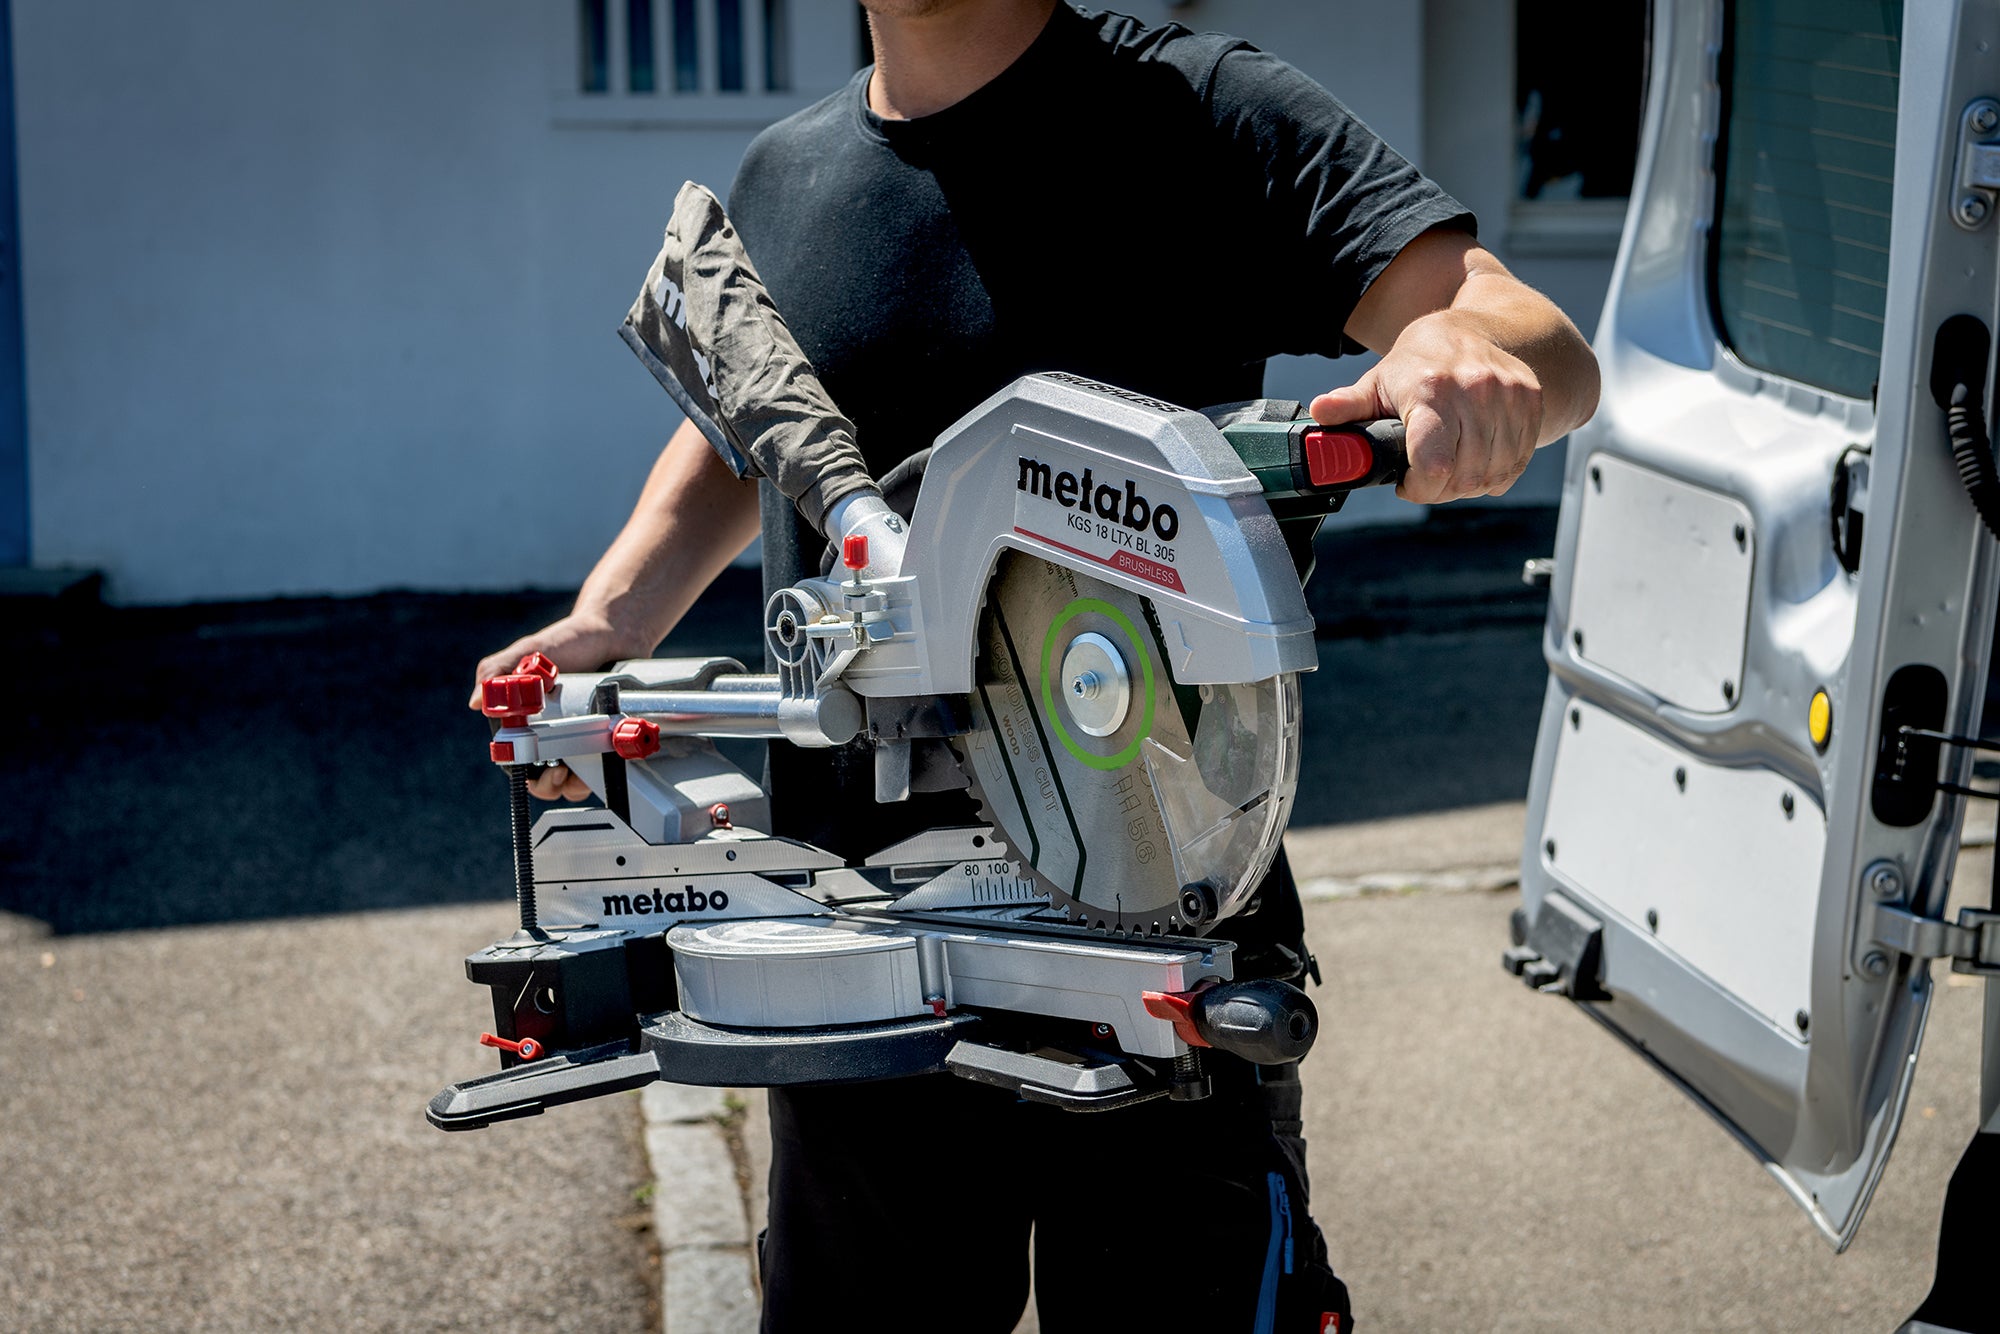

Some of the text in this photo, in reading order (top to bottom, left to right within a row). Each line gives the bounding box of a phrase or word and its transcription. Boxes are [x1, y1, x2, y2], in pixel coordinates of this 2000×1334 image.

[1042, 372, 1186, 413] BRUSHLESS
[1017, 456, 1179, 542] metabo
[1067, 512, 1175, 563] KGS 18 LTX BL 305
[1118, 554, 1175, 585] BRUSHLESS
[992, 641, 1060, 813] CORDLESS CUT
[1002, 714, 1021, 756] WOOD
[964, 864, 980, 876] 80
[987, 862, 1009, 875] 100
[602, 884, 729, 916] metabo
